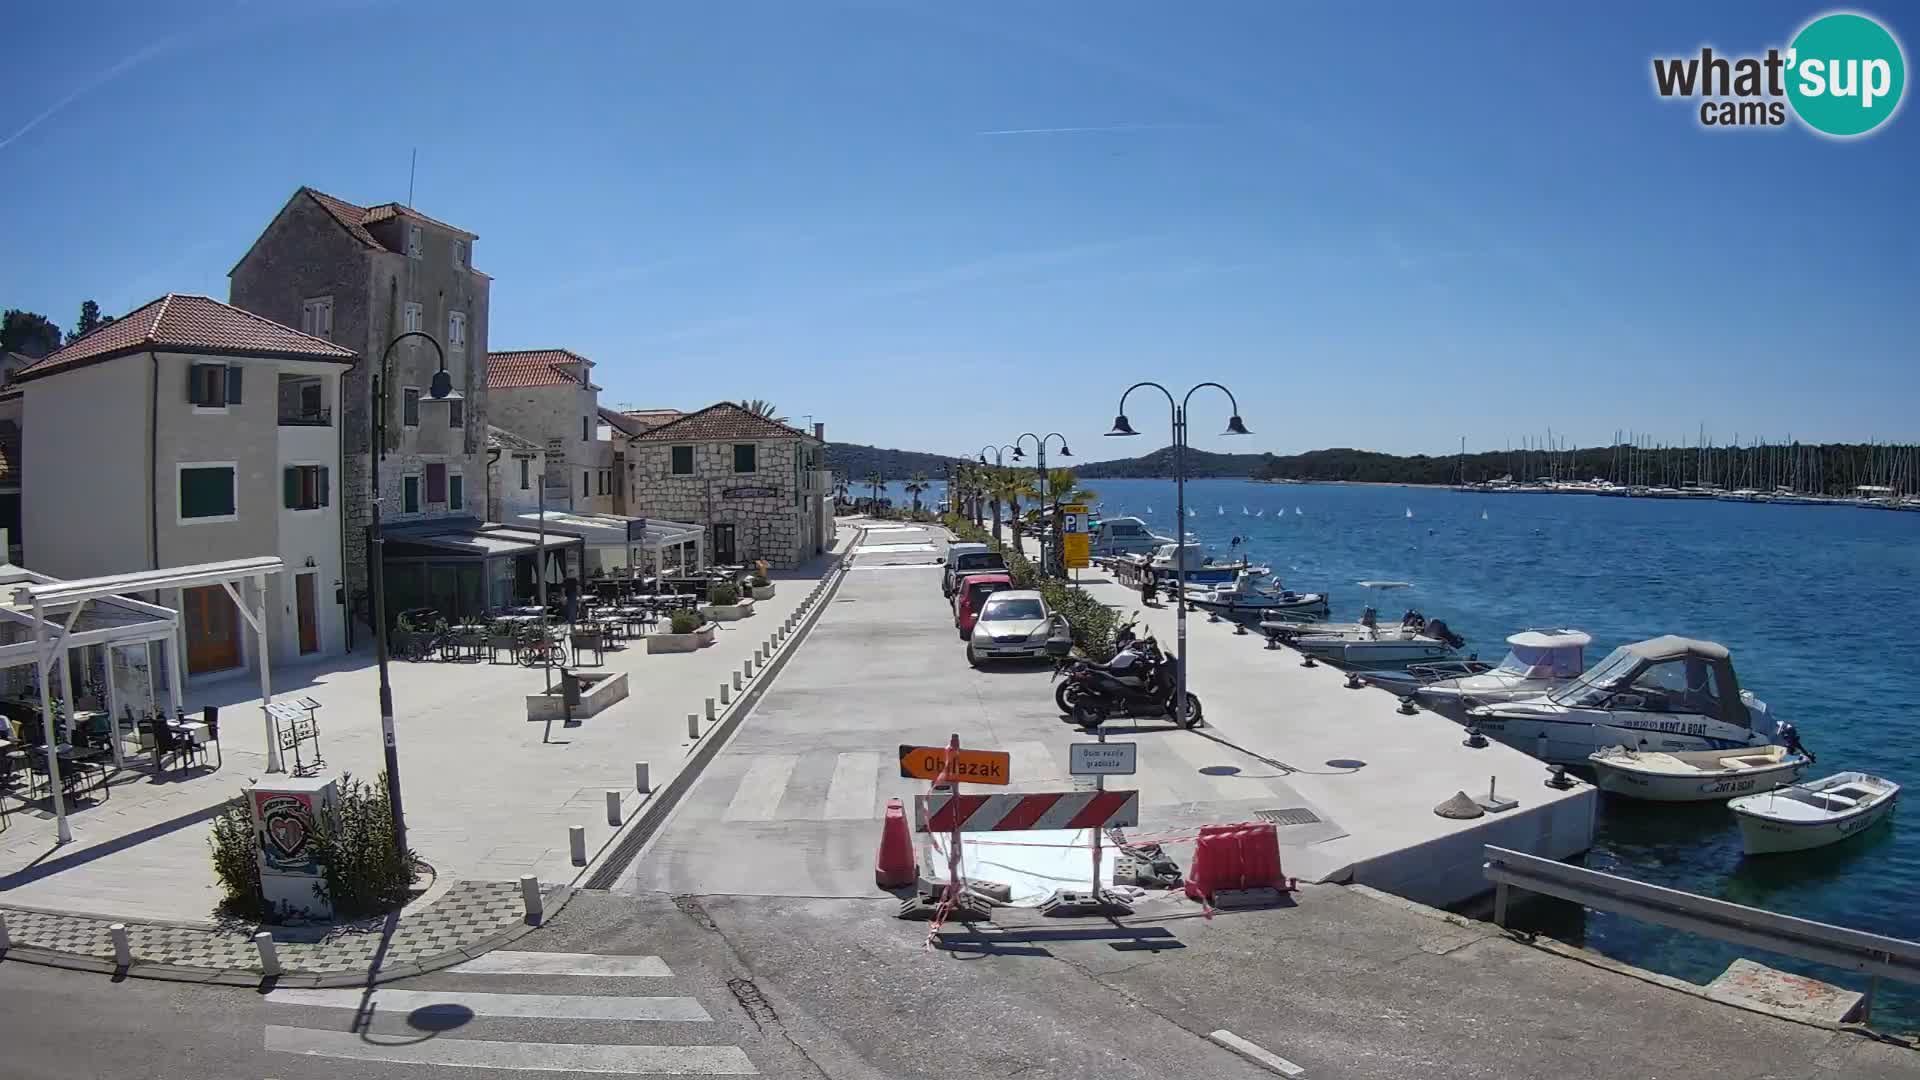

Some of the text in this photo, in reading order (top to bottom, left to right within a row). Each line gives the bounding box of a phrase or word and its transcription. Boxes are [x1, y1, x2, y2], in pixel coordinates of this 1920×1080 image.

[1659, 721, 1680, 734] RENT
[1681, 723, 1687, 732] A
[1687, 724, 1707, 736] BOAT
